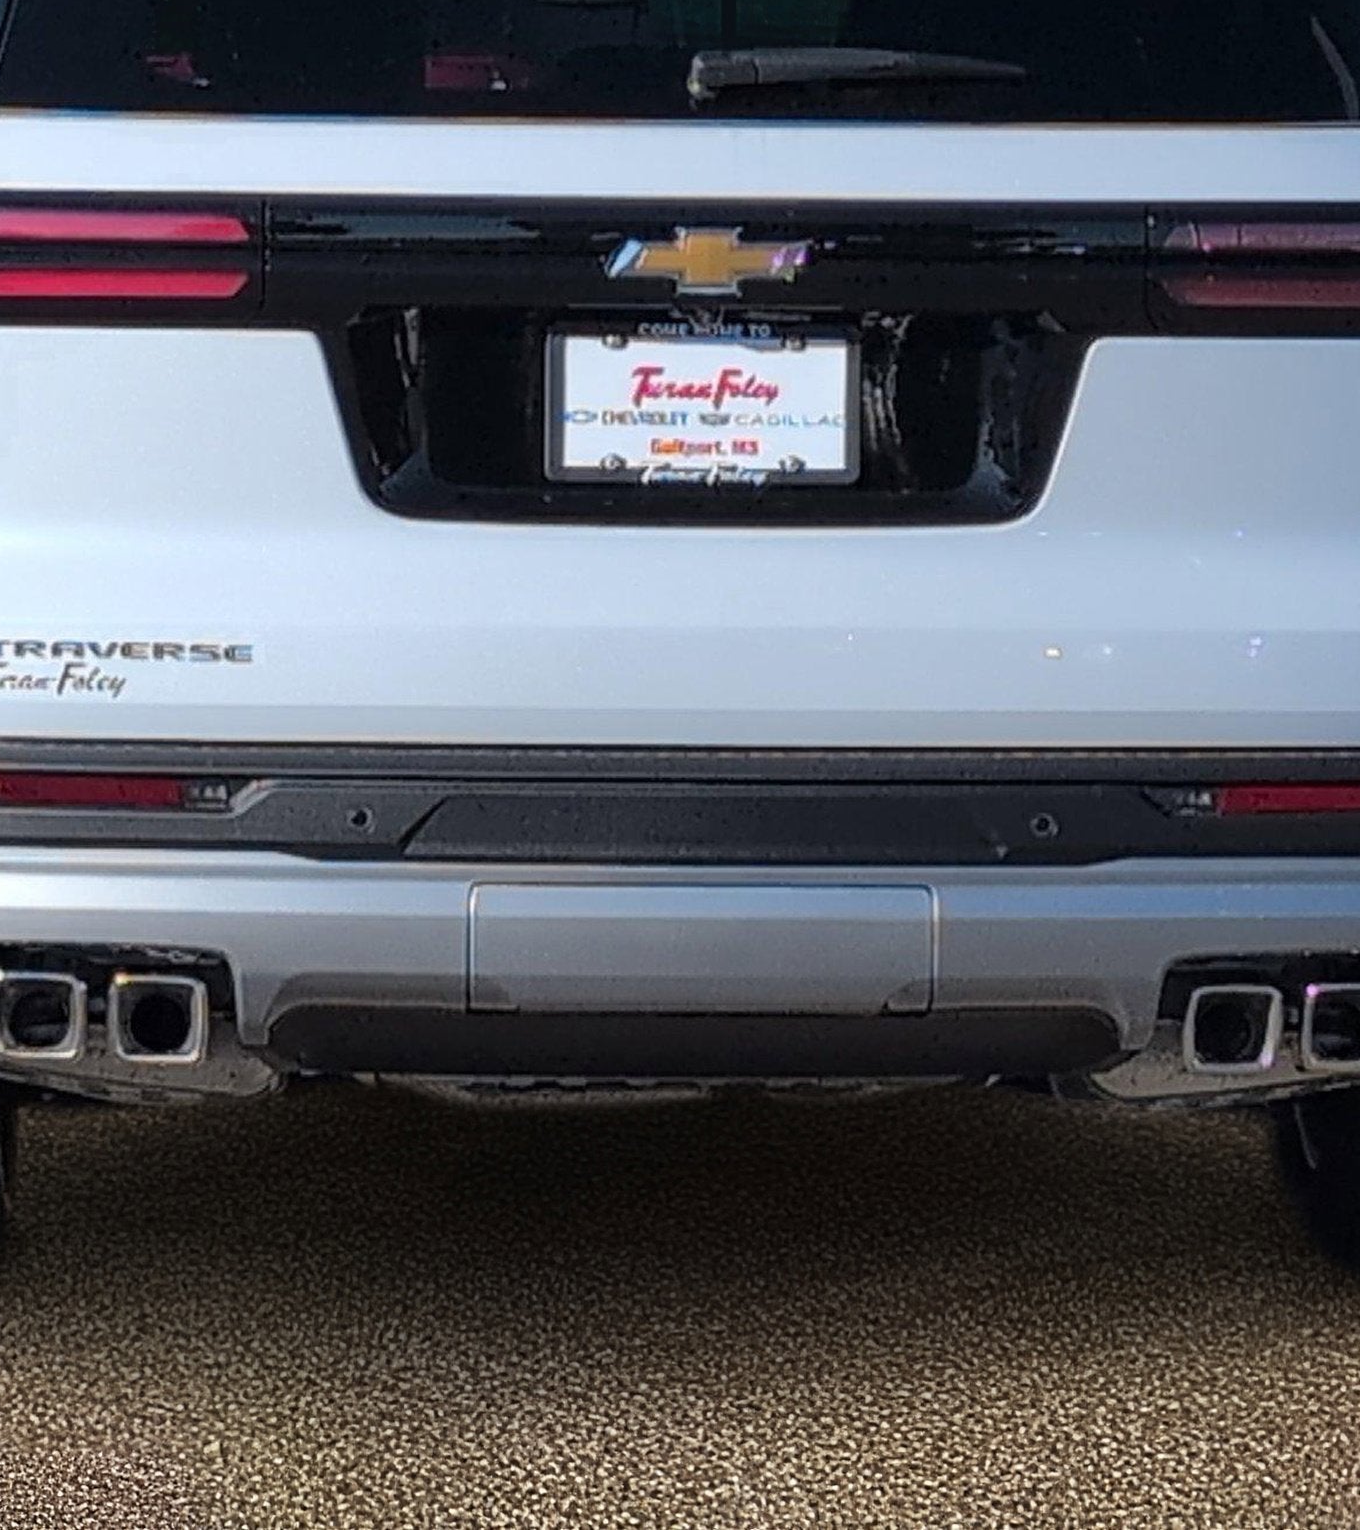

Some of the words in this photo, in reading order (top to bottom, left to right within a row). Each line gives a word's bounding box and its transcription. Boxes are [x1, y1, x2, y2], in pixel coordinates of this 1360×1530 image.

[632, 366, 712, 408] Turan
[712, 368, 779, 410] Foley
[601, 410, 690, 426] CHEVROLET
[734, 412, 844, 427] CADILLAC
[731, 439, 759, 455] MS
[56, 662, 127, 698] Foley
